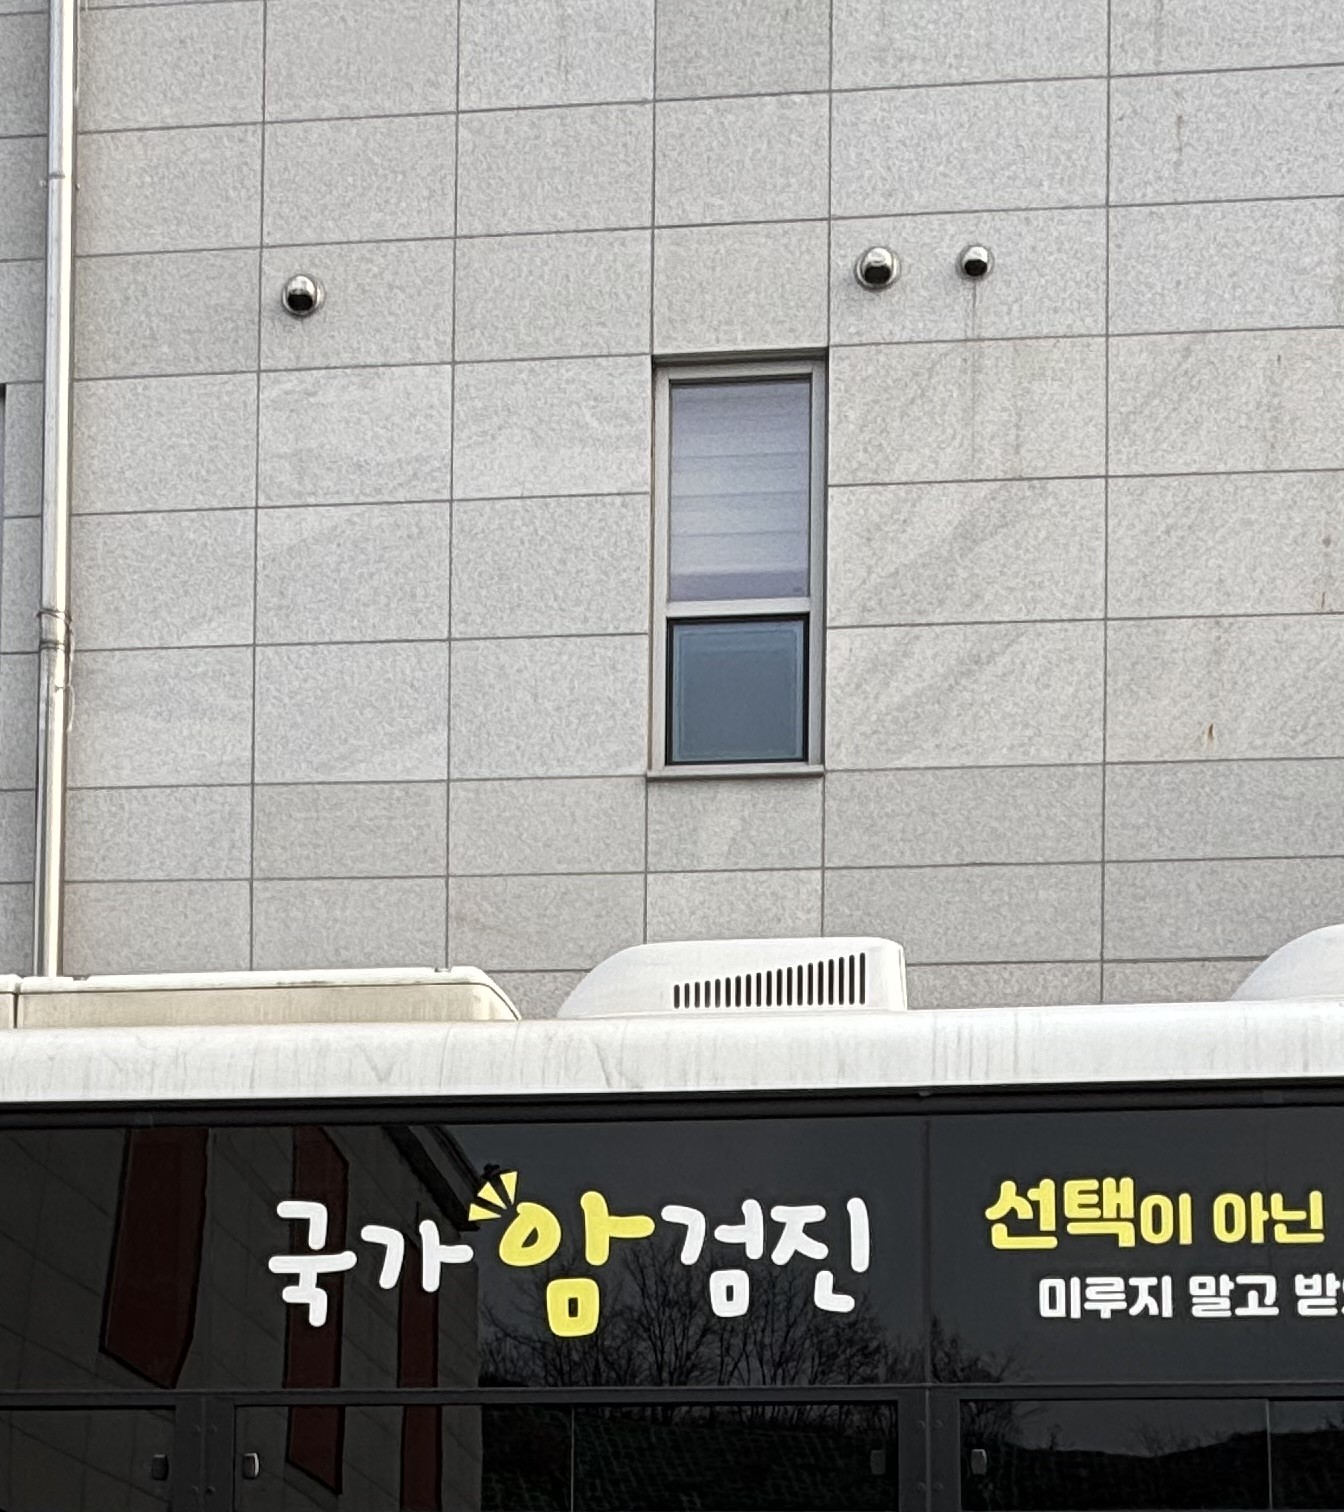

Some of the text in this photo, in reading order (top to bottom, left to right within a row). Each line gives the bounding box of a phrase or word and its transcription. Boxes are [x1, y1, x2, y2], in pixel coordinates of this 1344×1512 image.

[984, 1176, 1193, 1250] 선택이
[1212, 1190, 1326, 1244] 아닌
[1037, 1274, 1174, 1319] 미루지
[1189, 1273, 1281, 1318] 말고
